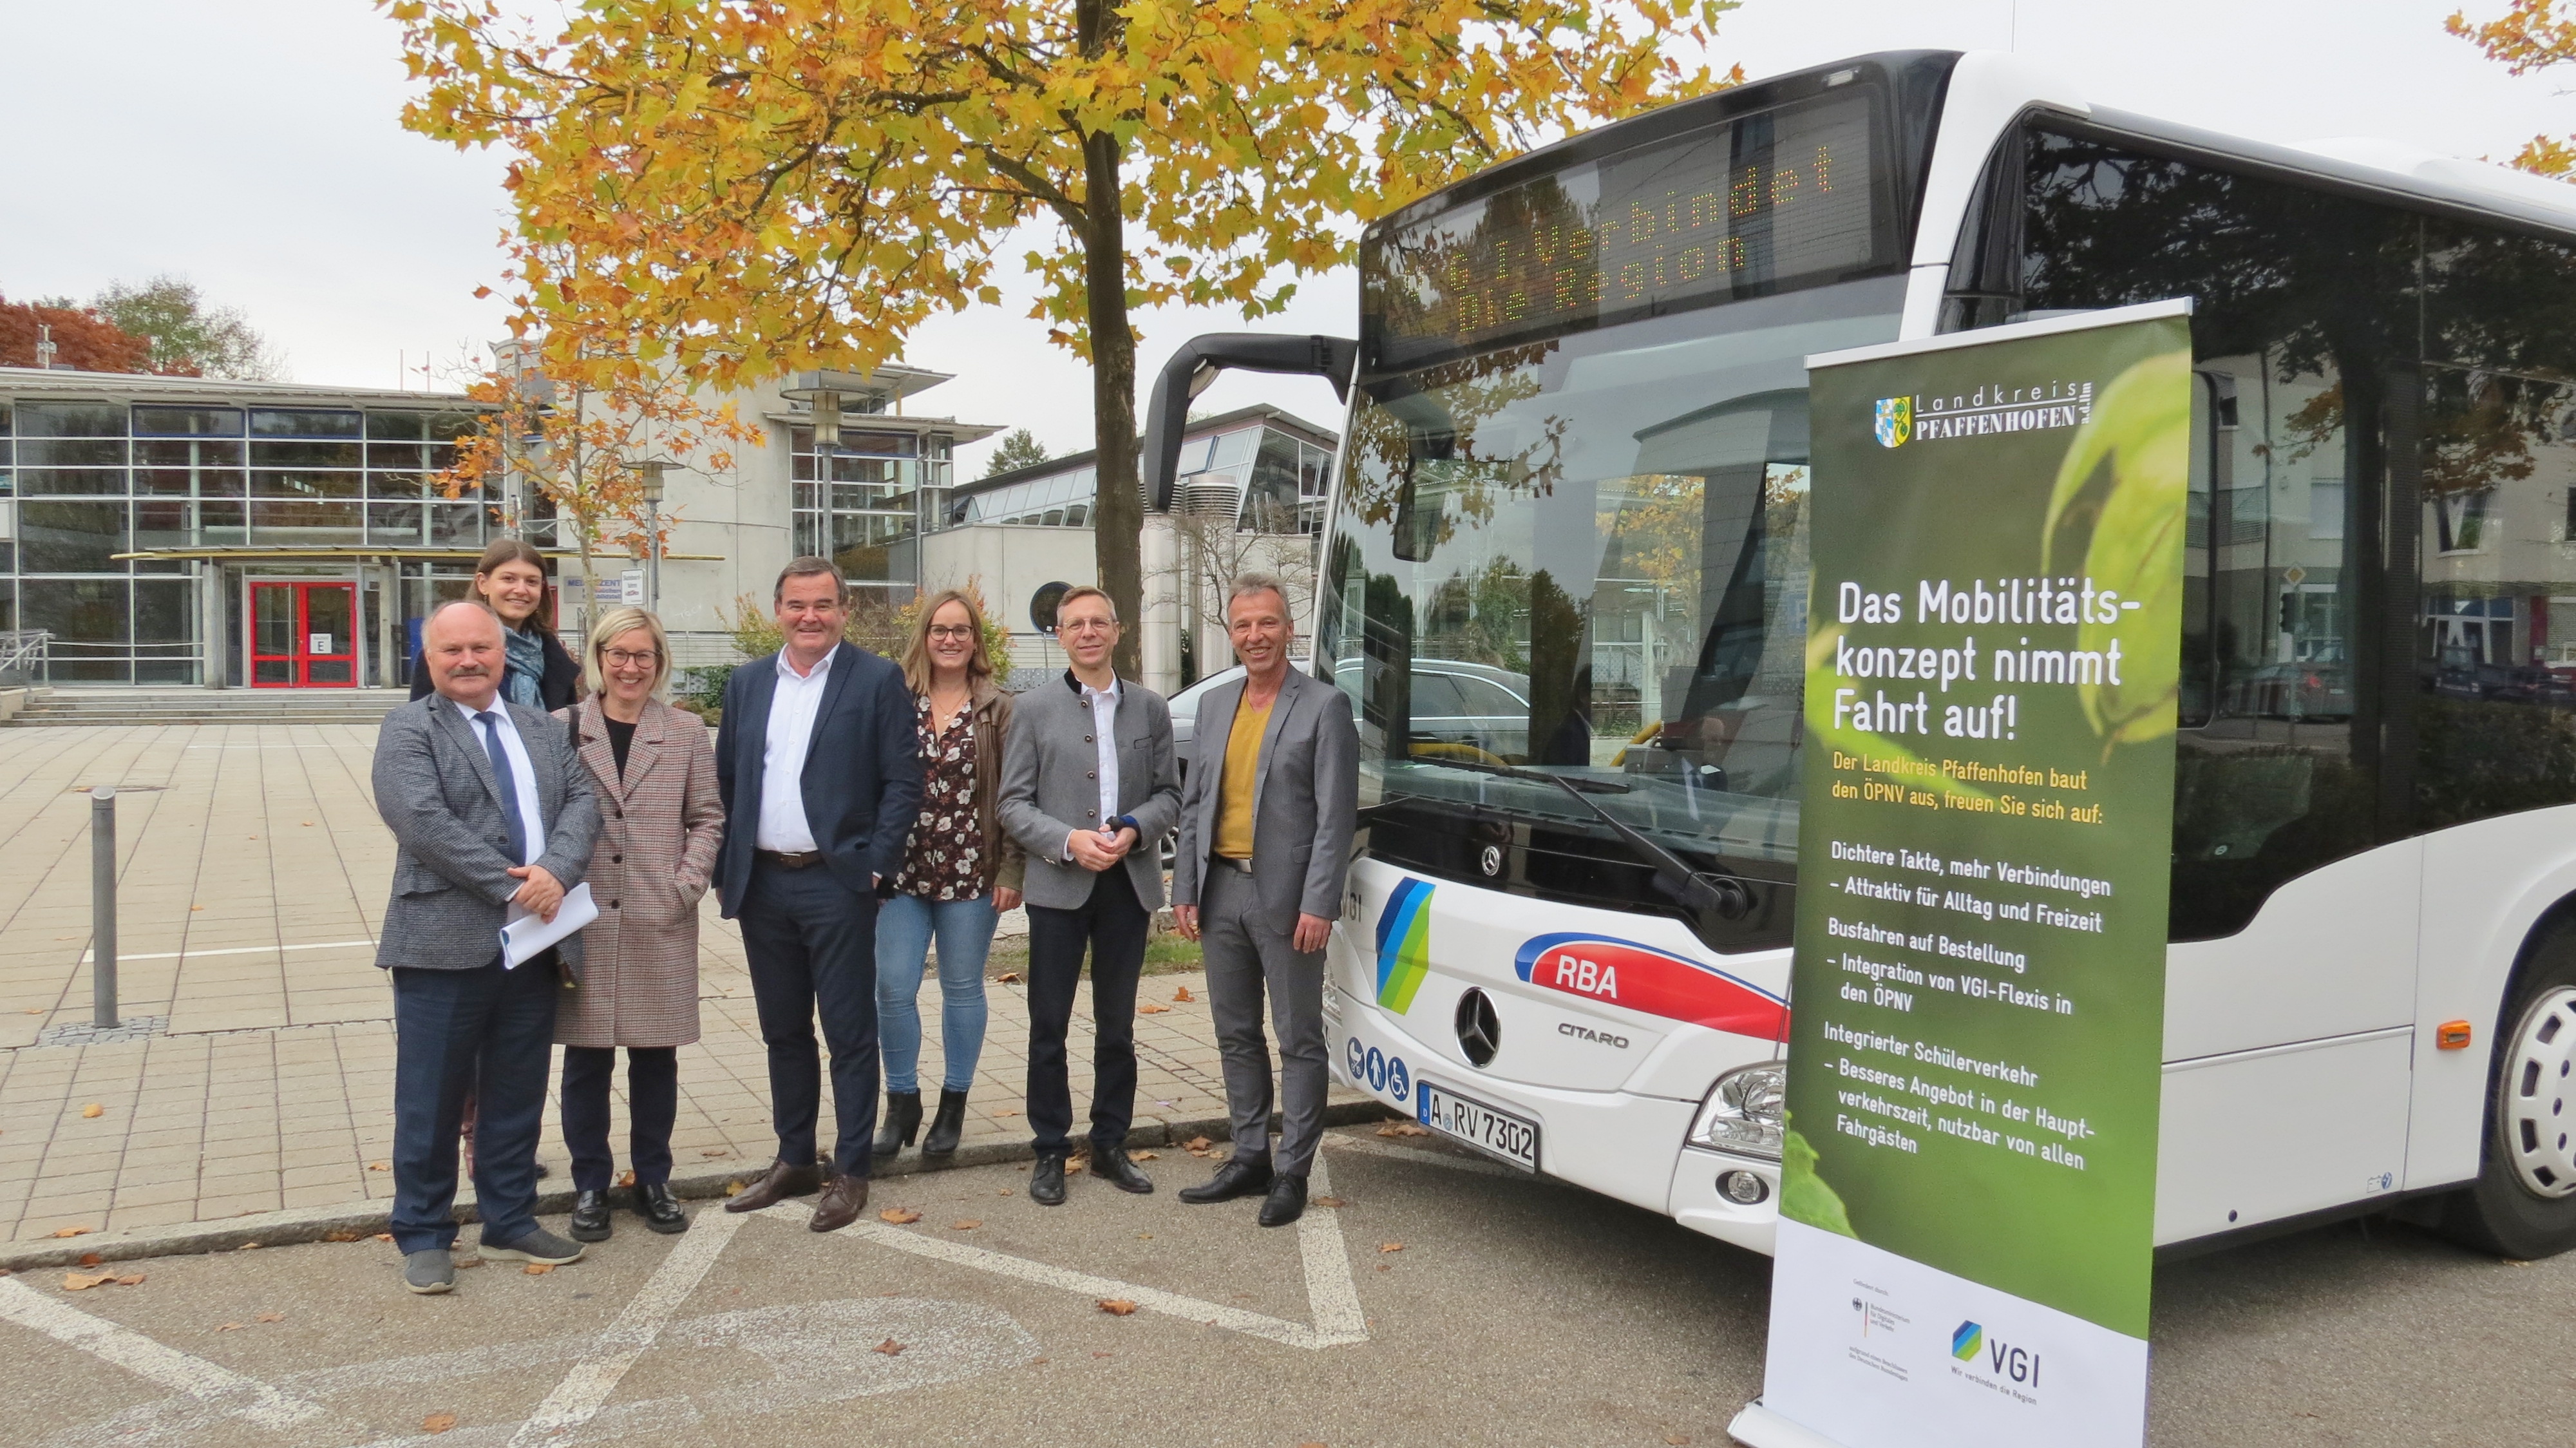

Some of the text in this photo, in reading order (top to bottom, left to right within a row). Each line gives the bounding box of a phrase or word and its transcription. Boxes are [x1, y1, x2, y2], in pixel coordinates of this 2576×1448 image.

[1459, 237, 1744, 332] Die Region
[1915, 380, 2076, 413] Landkreis
[1915, 405, 2076, 441] PFAFFENHOFEN
[1839, 582, 1901, 624] Das
[1918, 576, 2141, 624] Mobilitäts-
[317, 641, 325, 651] E
[1836, 635, 2123, 692] konzept nimmt
[1834, 688, 2016, 740] Fahrt auf!
[1832, 751, 2088, 790] Der Landkreis Pfaffenhofen baut
[1831, 777, 2102, 824] den ÖPNV aus, freuen Sie sich auf:
[1832, 841, 2111, 899] Dichtere Takte, mehr Verbindungen
[1844, 876, 1911, 902] Attraktiv
[1916, 886, 1939, 907] für
[1943, 890, 1993, 921] Alltag
[1999, 902, 2030, 922] und
[2036, 903, 2102, 933] Freizeit
[1828, 917, 2025, 974] Busfahren auf Bestellung
[1556, 954, 1617, 999] RBA
[1841, 981, 1913, 1012] den ÖPNV
[1842, 953, 1924, 987] Integration
[1928, 973, 1955, 992] von
[1960, 975, 2049, 1010] VGI-Flexis
[2056, 993, 2072, 1015] in
[1558, 1023, 1629, 1049] CITARO
[1824, 1021, 2038, 1088] Integrierter Schülerverkehr
[1839, 1057, 1905, 1091] Besseres
[1909, 1076, 1975, 1111] Angebot
[1980, 1092, 1996, 1114] in
[2002, 1099, 2031, 1122] der
[2036, 1106, 2095, 1140] Haupt-
[1431, 1094, 1533, 1161] A RV 7302
[1837, 1114, 1918, 1154] Fahrgästen
[1838, 1089, 2084, 1170] verkehrszeit, nutzbar von allen
[1951, 1365, 2037, 1405] Wir verbinden die Region
[1991, 1338, 2039, 1388] VGI
